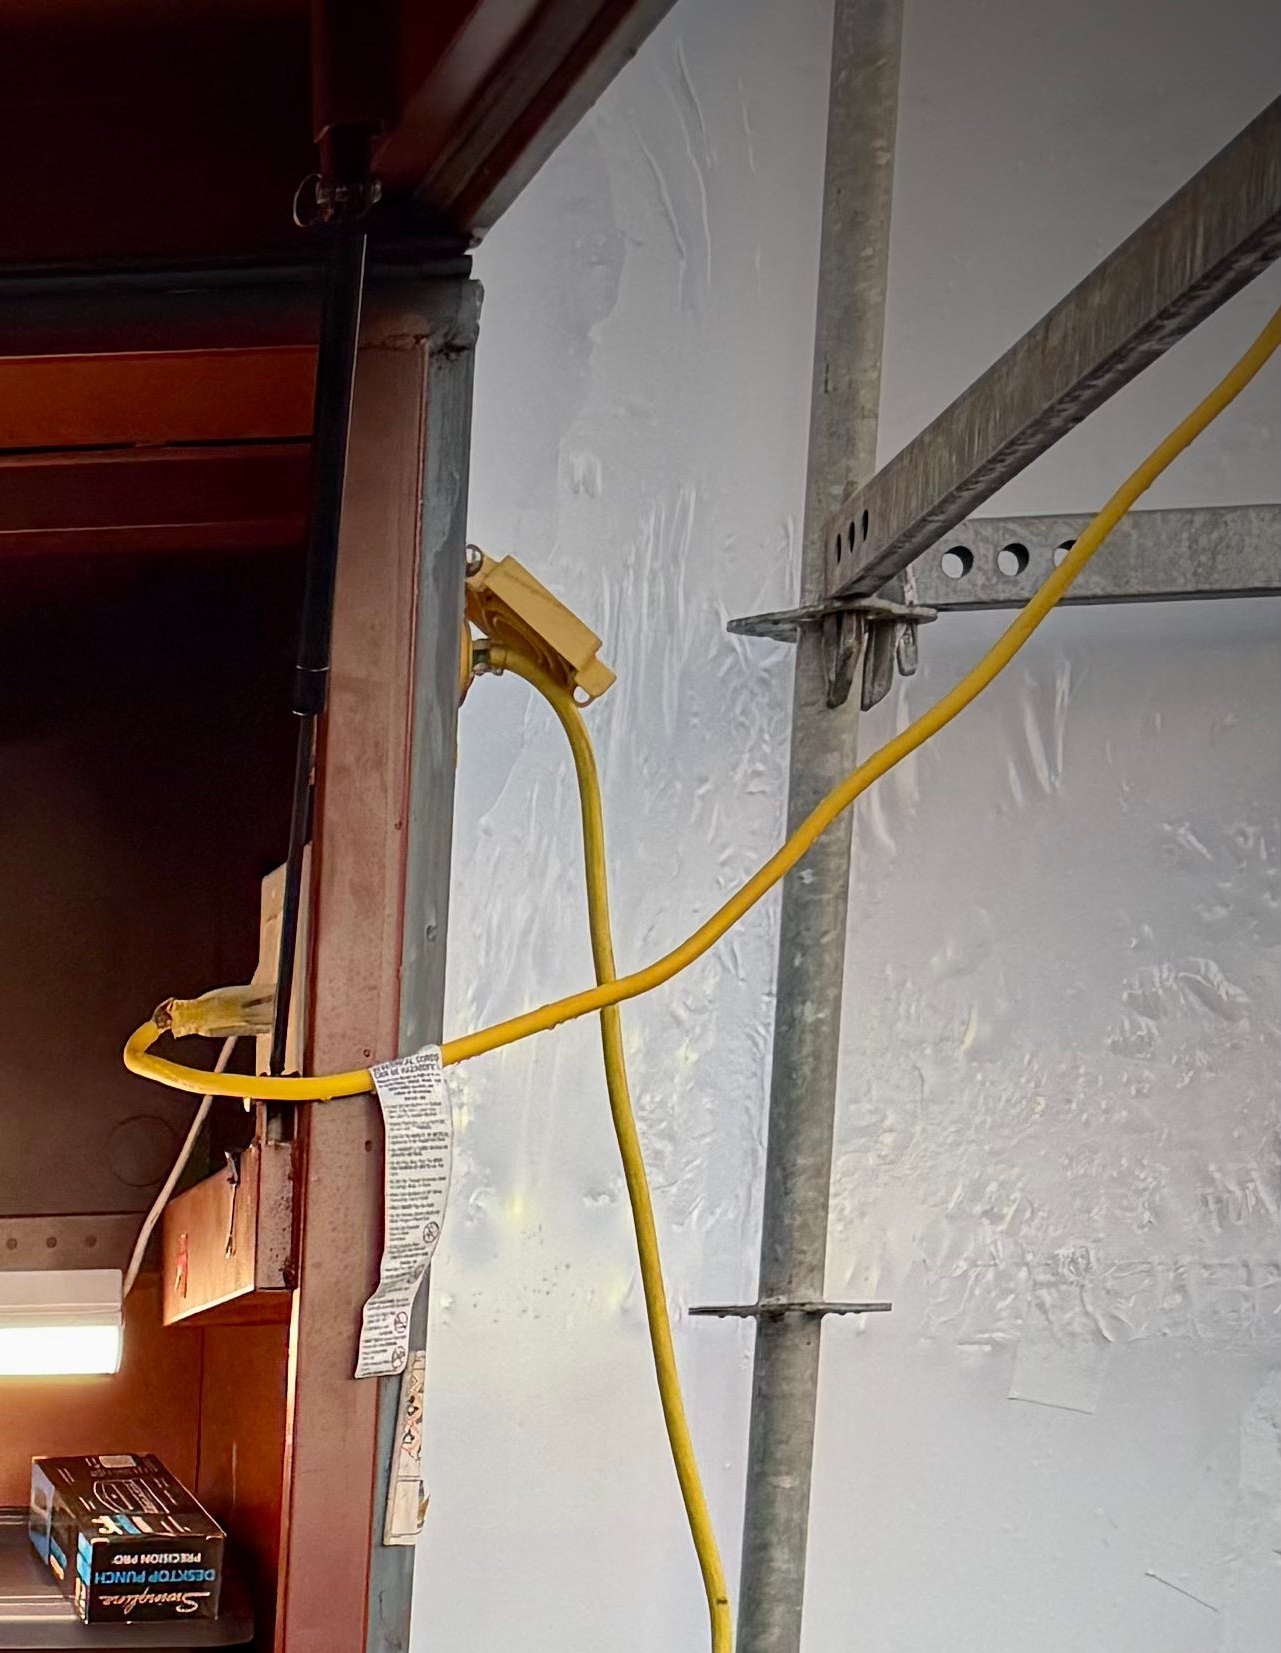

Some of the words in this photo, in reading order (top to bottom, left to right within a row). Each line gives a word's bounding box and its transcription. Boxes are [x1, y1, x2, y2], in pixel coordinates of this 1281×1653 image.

[94, 1570, 146, 1584] PUNCH
[148, 1568, 216, 1582] DESKTOP
[98, 1585, 211, 1615] Swingline
